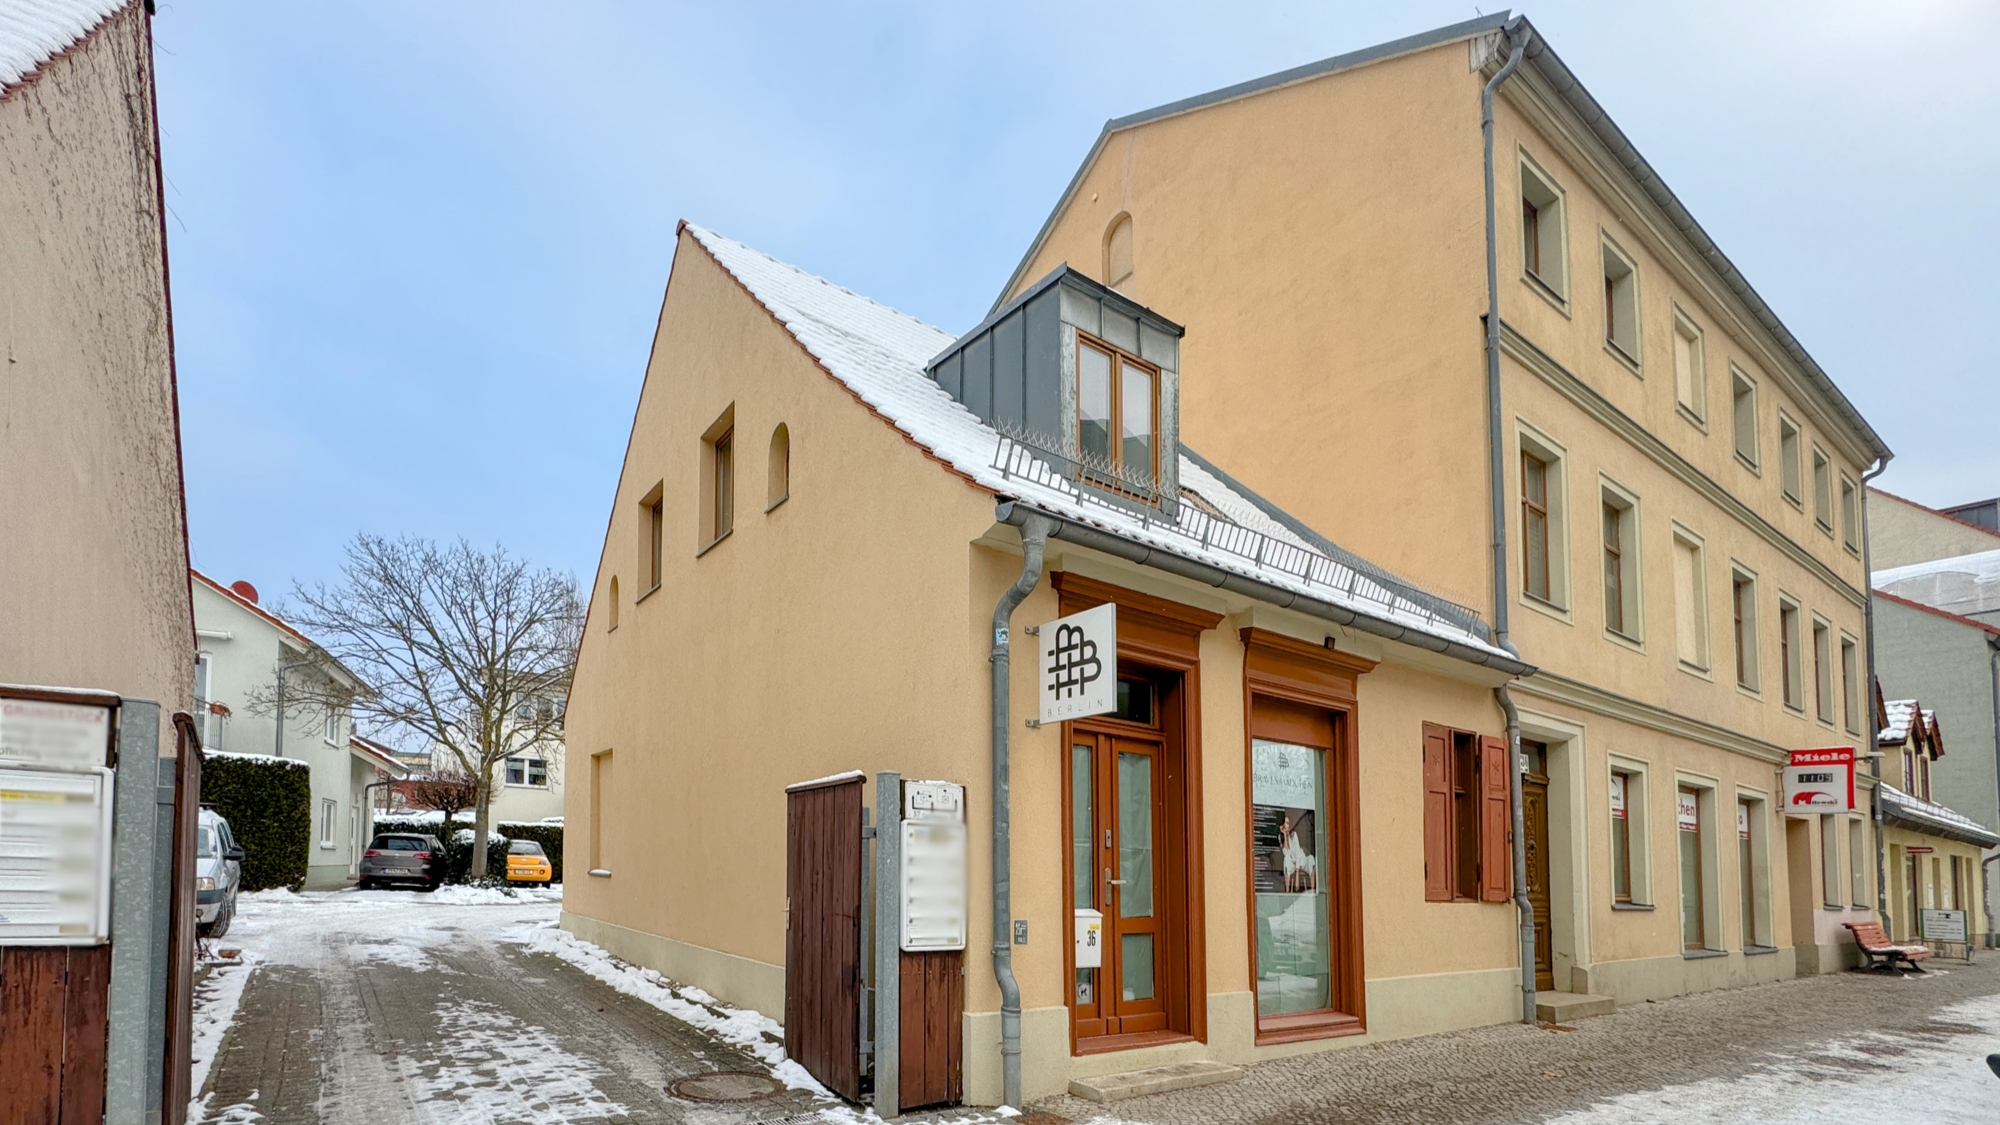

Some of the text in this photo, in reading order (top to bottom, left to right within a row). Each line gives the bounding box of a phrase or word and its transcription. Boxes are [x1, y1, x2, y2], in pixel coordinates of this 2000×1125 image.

[1048, 699, 1103, 718] BERLIN
[1793, 752, 1851, 763] Miele
[1087, 930, 1096, 947] 36
